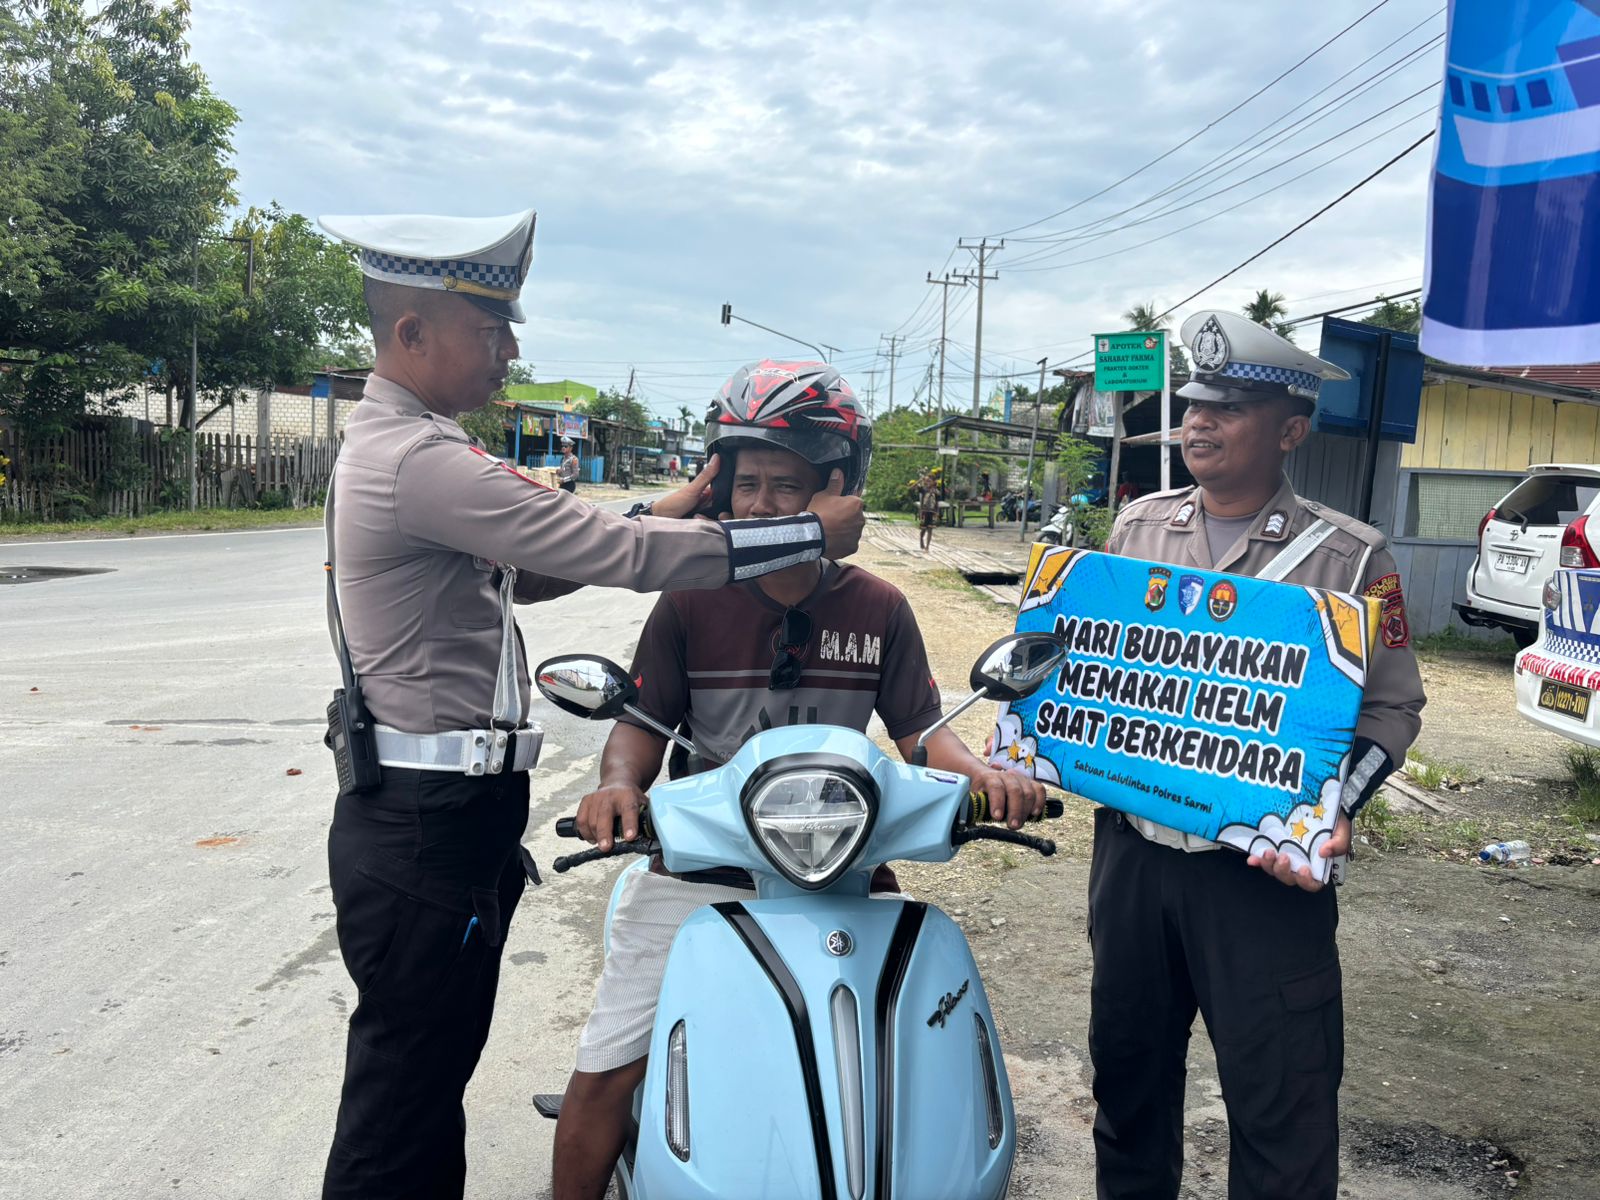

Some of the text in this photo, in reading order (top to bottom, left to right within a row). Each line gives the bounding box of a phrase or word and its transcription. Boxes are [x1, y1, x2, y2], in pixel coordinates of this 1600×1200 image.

[1099, 354, 1129, 363] SAHABAT
[820, 630, 880, 664] M.A.M
[1054, 617, 1307, 684] MARI BUDAYAKAN
[1058, 661, 1286, 733] MEMAKAI HELM
[1549, 662, 1590, 687] JALAN
[1036, 702, 1304, 790] SAAT BERKENDARA
[1074, 759, 1213, 813] Satuan Lalulintas Polres Sarmi
